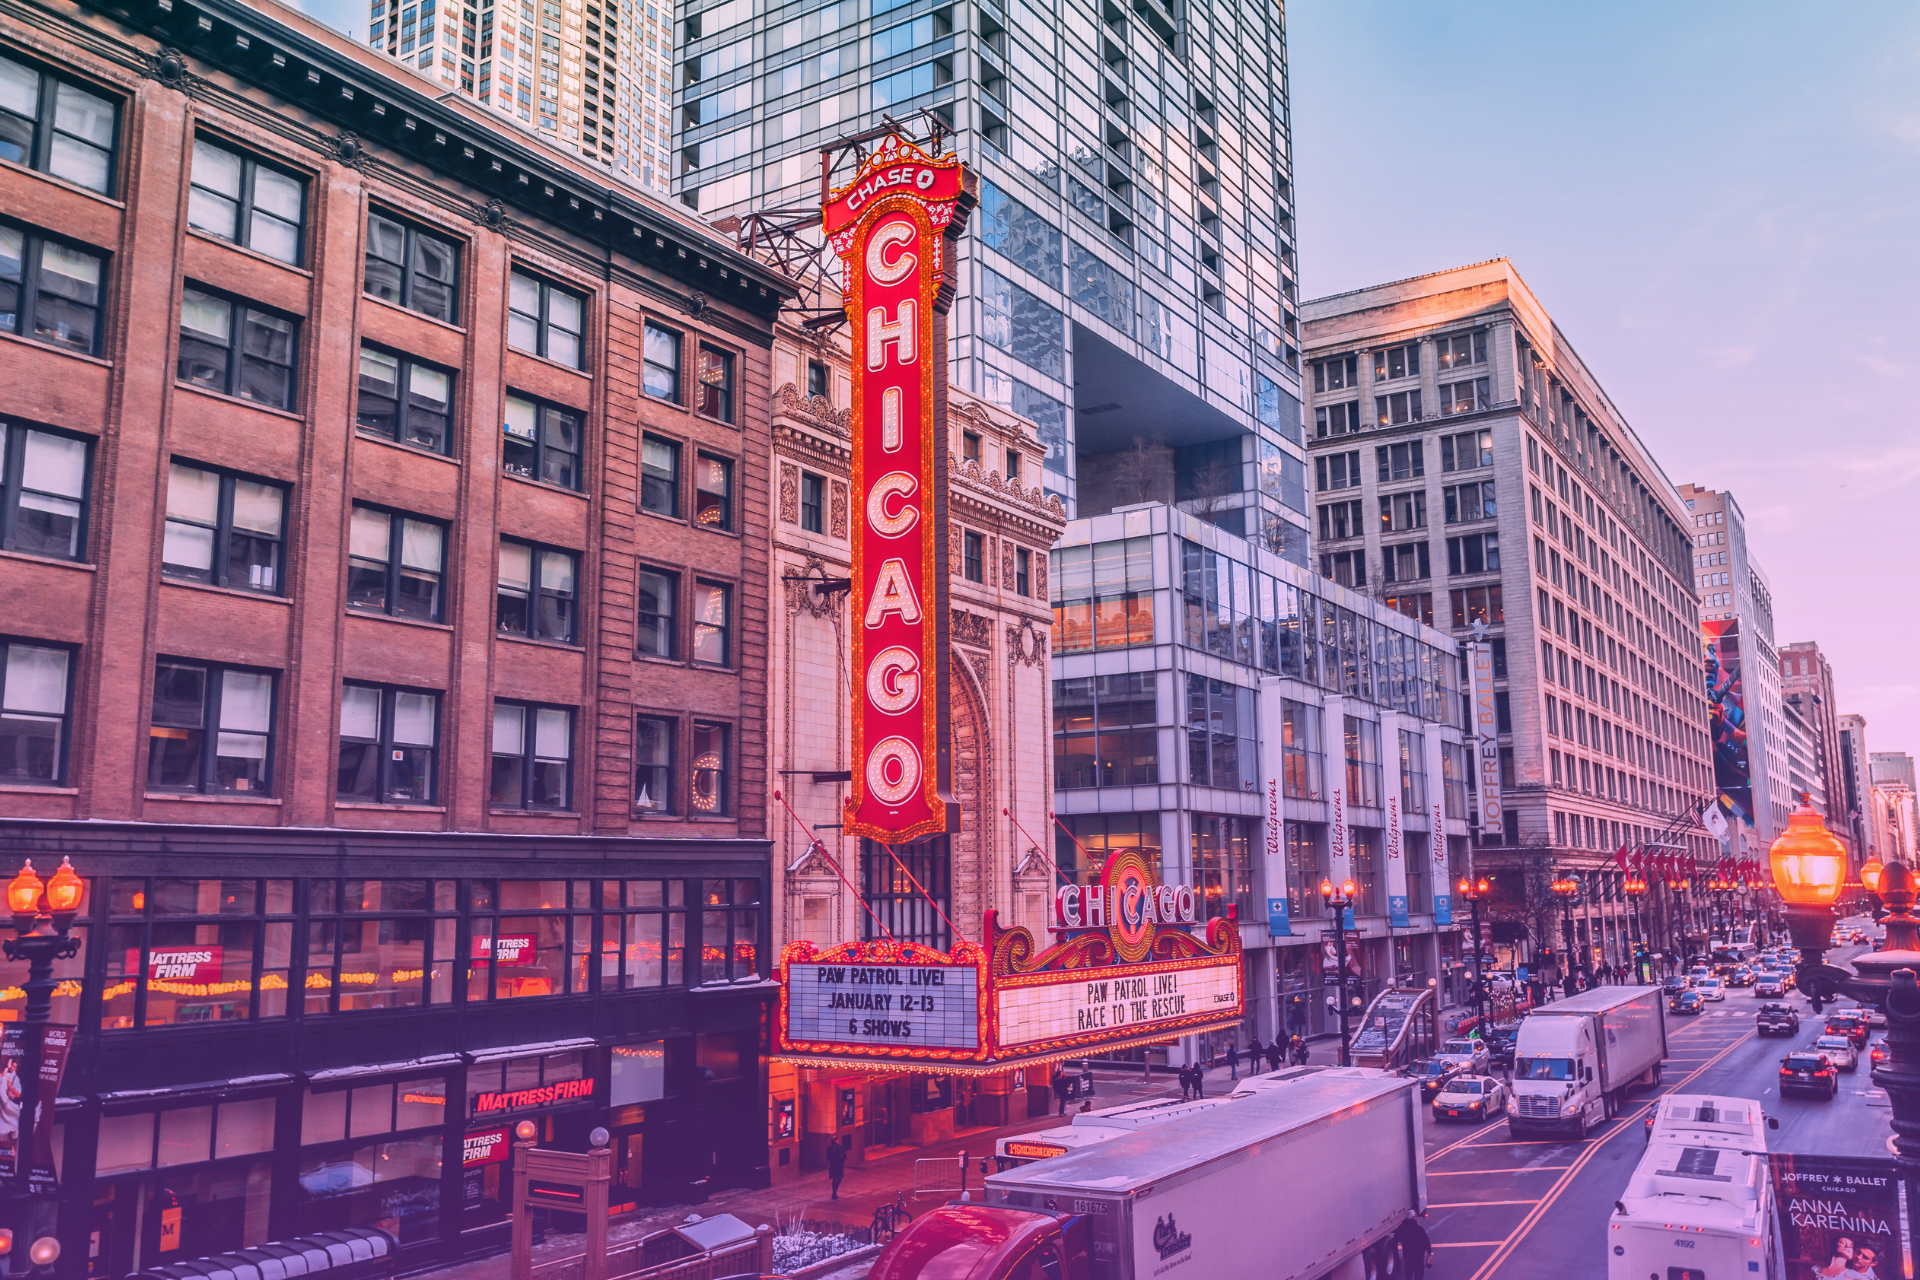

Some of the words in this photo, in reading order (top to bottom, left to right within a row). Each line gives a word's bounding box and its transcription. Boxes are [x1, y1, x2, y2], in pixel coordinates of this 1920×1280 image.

[847, 168, 914, 210] CHASE
[865, 220, 922, 806] CHICAGO
[1475, 645, 1495, 725] BALLET
[1482, 732, 1502, 831] JOFFREY
[1266, 779, 1282, 855] Walgreens
[1332, 788, 1347, 858] Walgreens
[1387, 796, 1402, 860] Walgreens
[1433, 803, 1446, 863] Walgreens
[1059, 884, 1195, 926] CHICAGO
[480, 938, 529, 949] MTTRESS
[155, 963, 197, 978] FIRM
[818, 967, 845, 983] PAW
[851, 968, 903, 985] PATROL
[909, 969, 945, 986] LIVE!
[1088, 982, 1108, 1005] PAW
[1114, 978, 1149, 1001] PATROL
[1153, 974, 1178, 996] LIVE!
[1213, 994, 1230, 1003] CHASE
[827, 993, 892, 1010] JANUARY
[900, 995, 934, 1012] 12-13
[1078, 1006, 1106, 1030] RACE
[1113, 1003, 1125, 1025] TO
[1130, 1000, 1148, 1022] THE
[1152, 995, 1186, 1018] RESCUE
[48, 1030, 67, 1038] WORLD
[849, 1018, 858, 1035] 6
[862, 1019, 911, 1037] SHOWS
[463, 1145, 491, 1161] FIRM
[1008, 1143, 1021, 1155] 146
[1782, 1173, 1830, 1183] JOFFREY
[1846, 1176, 1887, 1186] BALLET
[1075, 1201, 1107, 1214] 161675
[1788, 1199, 1847, 1215] ANNA
[1153, 1212, 1177, 1252] Clark
[1790, 1213, 1891, 1235] KARENINA
[1160, 1231, 1192, 1261] Transfer
[1674, 1238, 1696, 1249] 4192
